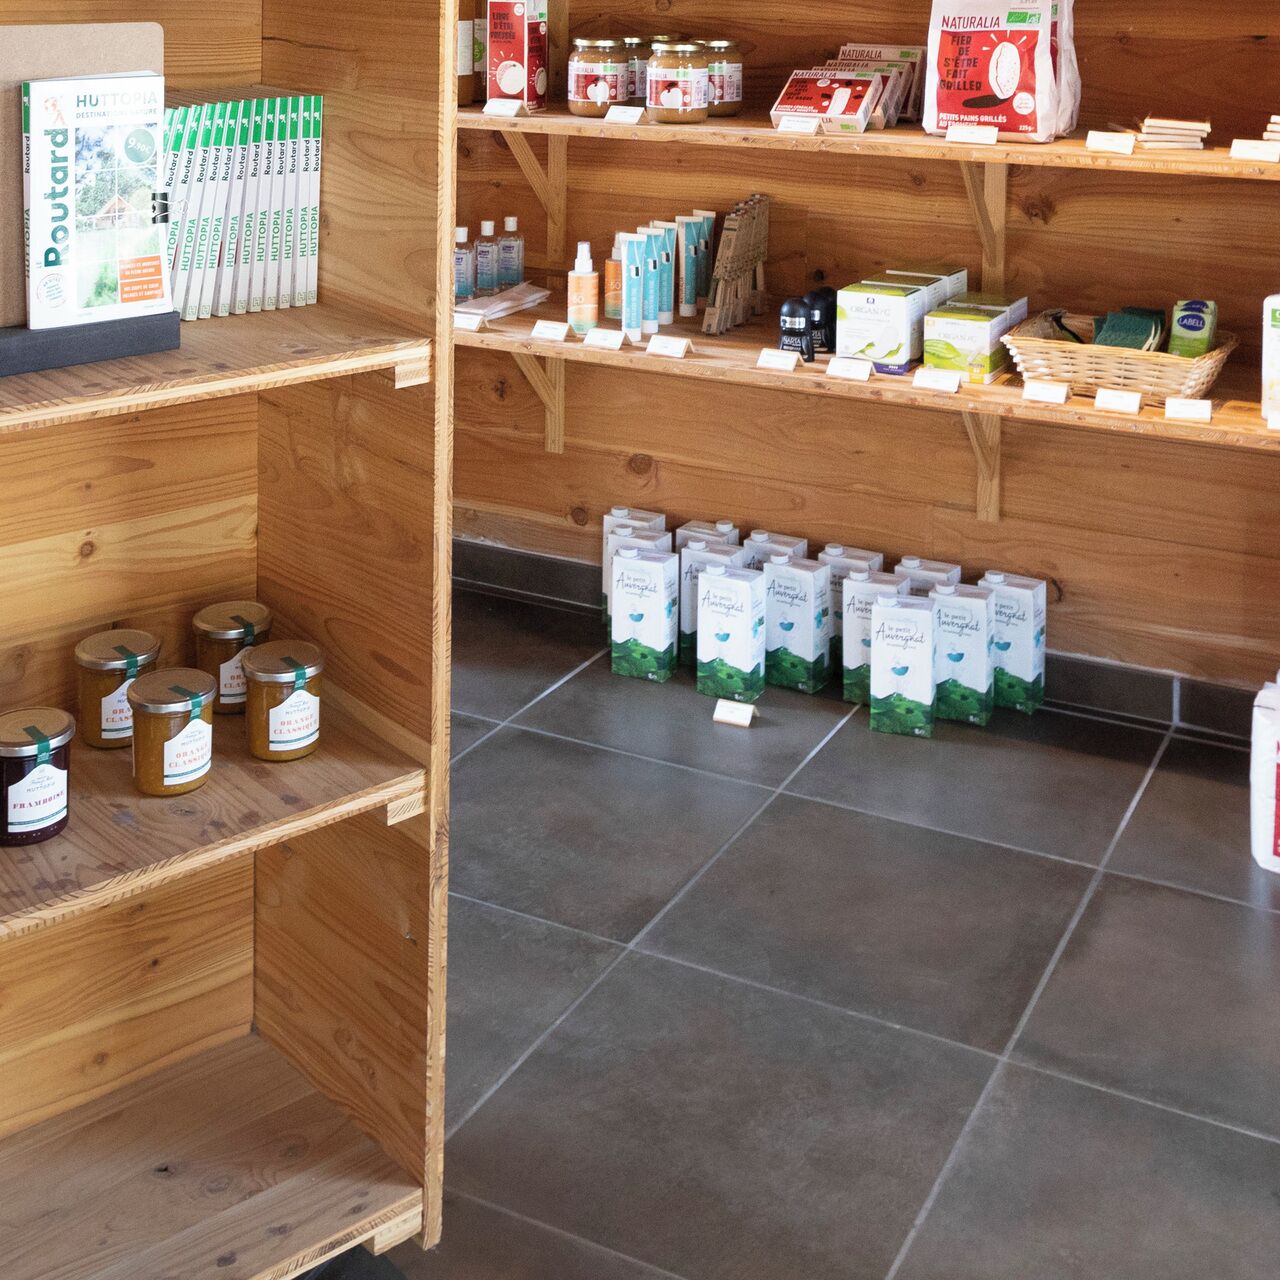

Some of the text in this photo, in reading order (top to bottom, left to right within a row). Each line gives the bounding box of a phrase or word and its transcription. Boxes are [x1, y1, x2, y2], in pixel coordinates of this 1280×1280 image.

[942, 16, 1000, 29] NATURALIA
[951, 36, 972, 45] FIER
[959, 47, 969, 55] DE
[841, 50, 882, 59] NATURALIA
[944, 57, 978, 67] S'ÊTRE
[946, 69, 968, 78] FAIT
[941, 80, 982, 91] GRILLER
[980, 114, 1006, 122] GRILLÉS
[181, 151, 193, 184] Routard
[210, 148, 220, 181] Routard
[237, 147, 246, 180] Routard
[264, 142, 273, 175] Routard
[44, 128, 69, 268] Routard
[209, 217, 223, 268] HUTTOPIA
[243, 212, 254, 264] HUTTOPIA
[271, 210, 281, 261] HUTTOPIA
[300, 207, 308, 256] HUTTOPIA
[181, 218, 196, 271] HUTTOPIA
[616, 572, 657, 593] Auvergnat
[767, 579, 809, 602] Auvergnat
[876, 622, 926, 644] Auvergnat
[13, 791, 64, 810] FRAMBOISE
